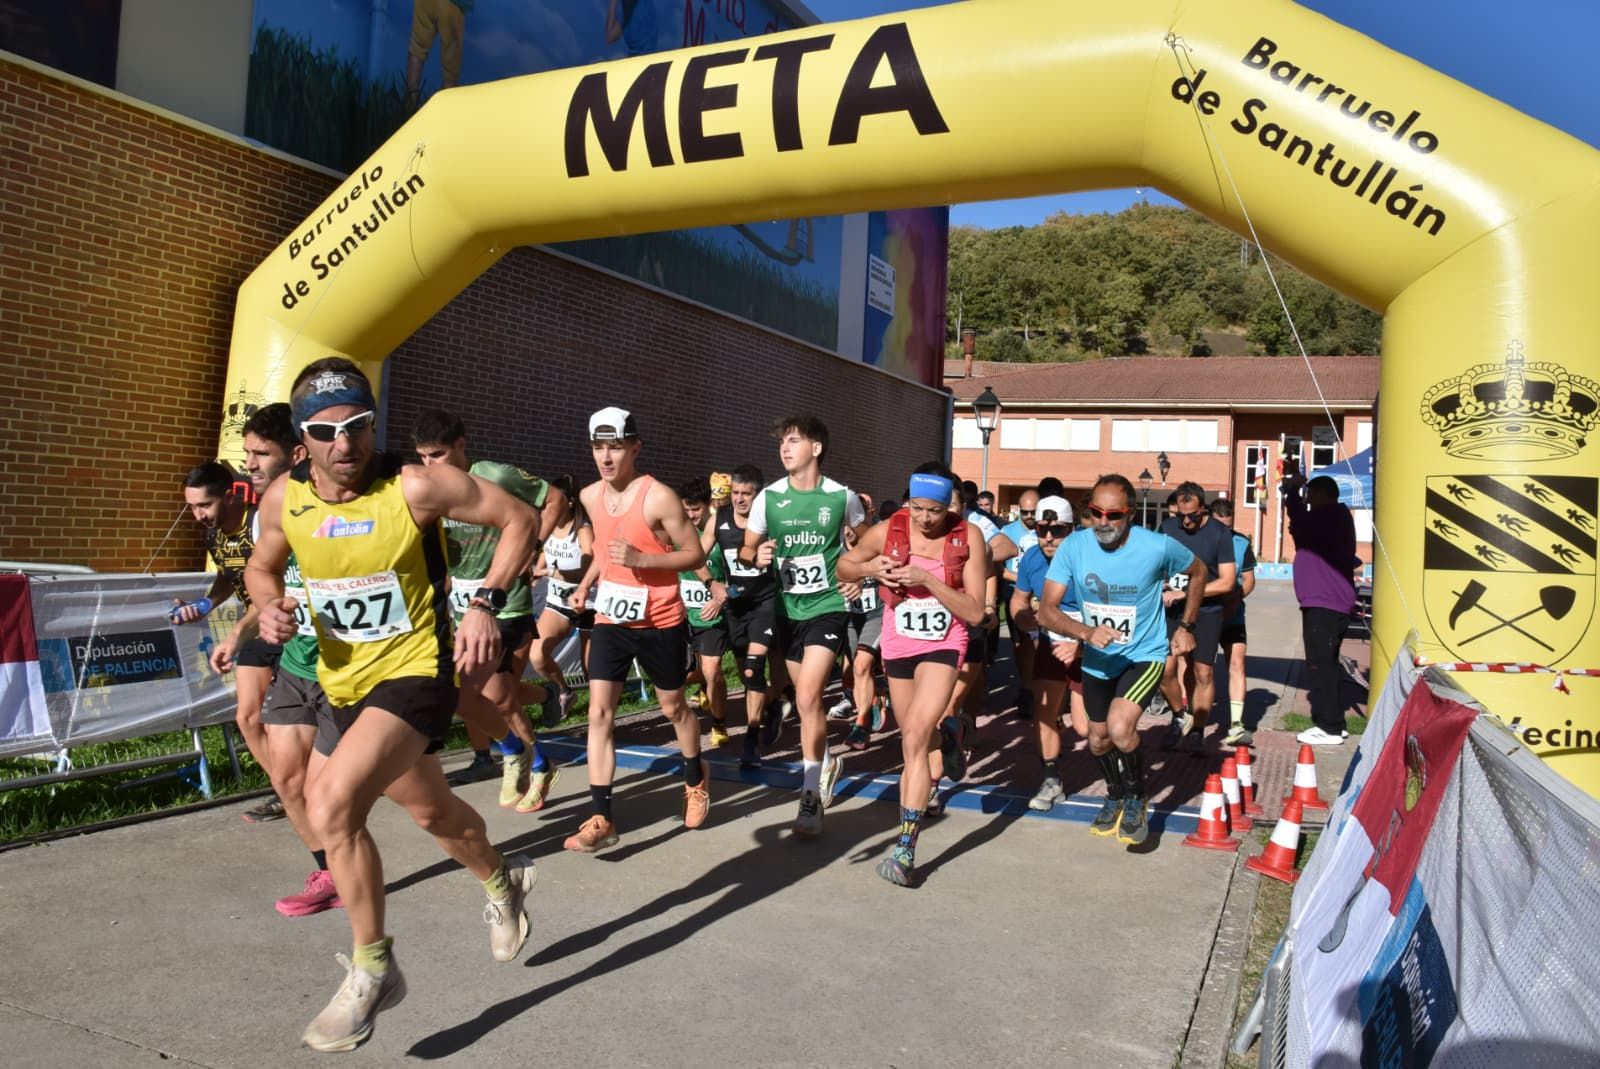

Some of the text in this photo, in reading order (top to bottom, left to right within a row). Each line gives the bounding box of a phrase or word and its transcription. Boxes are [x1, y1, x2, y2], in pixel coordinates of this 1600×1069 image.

[564, 22, 950, 178] META
[1240, 37, 1439, 155] Barruelo
[1171, 69, 1447, 237] de Santullán
[288, 164, 383, 260] Barruelo
[281, 173, 425, 311] de Santullán
[333, 523, 369, 537] antolin
[784, 531, 826, 548] gullón
[784, 565, 823, 586] 132
[685, 589, 713, 602] 108
[323, 591, 392, 630] 127
[601, 596, 641, 620] 105
[902, 611, 946, 632] 113
[75, 640, 156, 660] Diputación
[104, 657, 177, 677] PALENCIA
[1510, 716, 1600, 749] ecin
